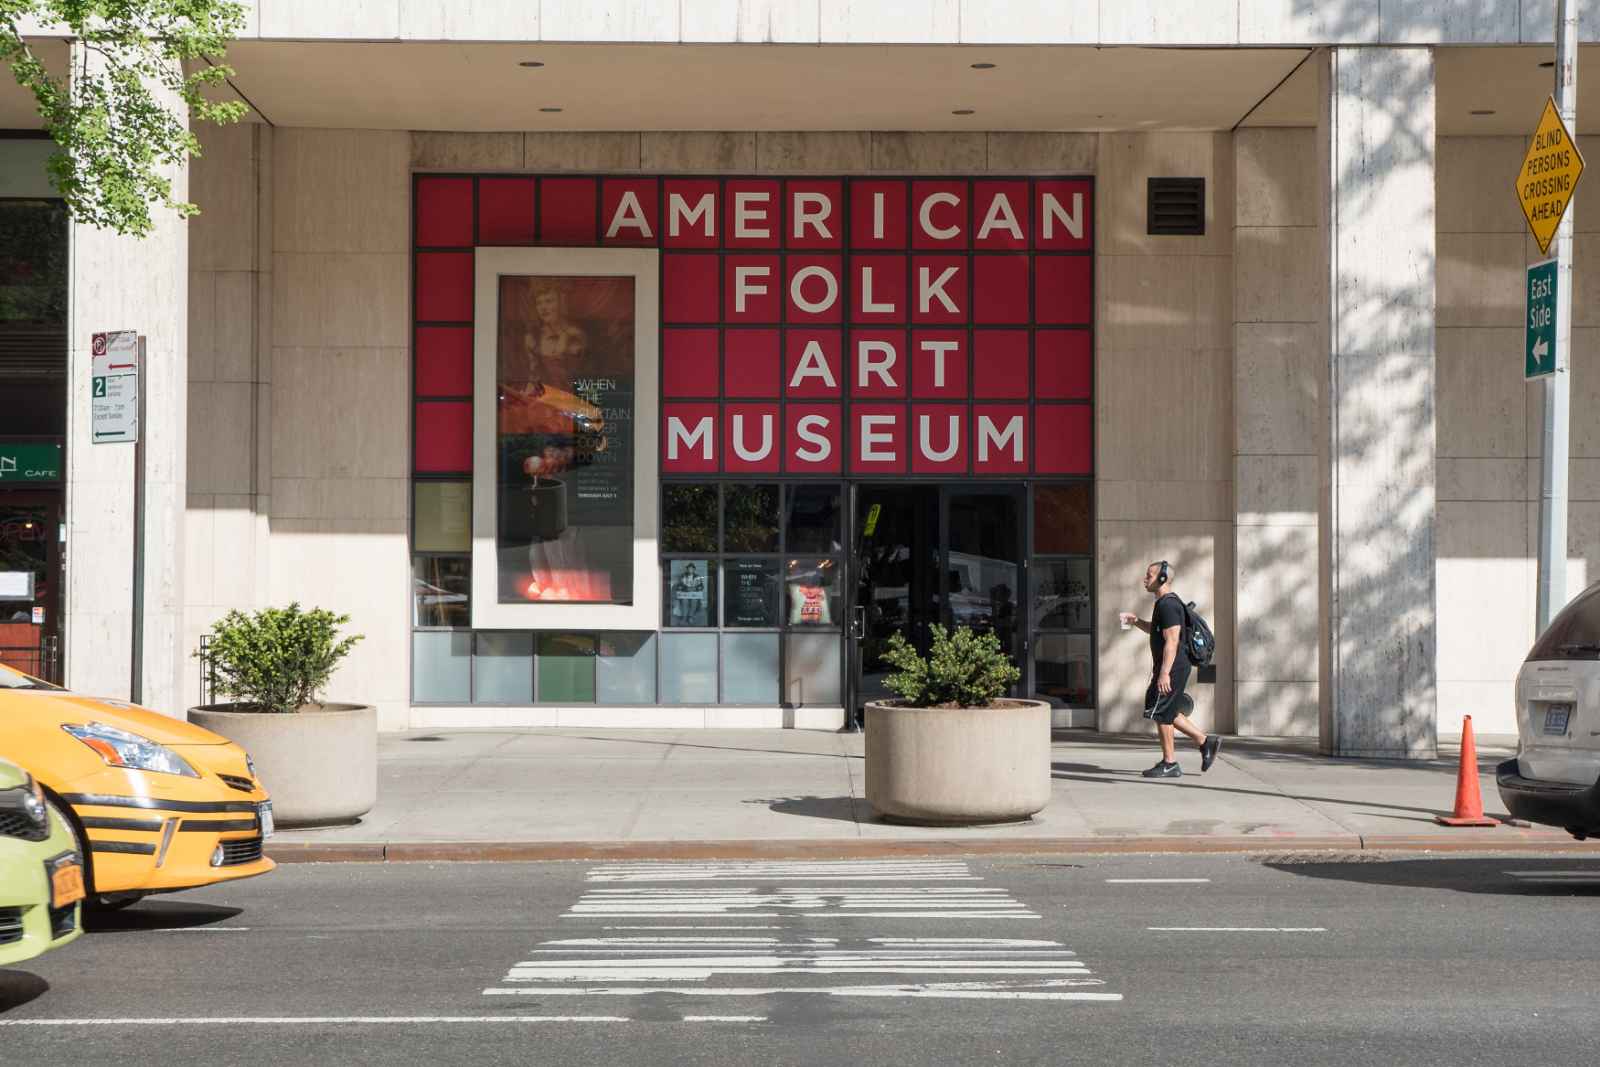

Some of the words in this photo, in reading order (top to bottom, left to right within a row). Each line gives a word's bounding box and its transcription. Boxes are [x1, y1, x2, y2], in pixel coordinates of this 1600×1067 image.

[1536, 128, 1561, 151] BLIND
[1527, 150, 1570, 176] PERSONS
[1524, 174, 1570, 200] CROSSING
[605, 190, 1085, 240] AMERICAN
[1531, 200, 1562, 221] AHEAD
[735, 266, 960, 314] FOLK
[1531, 273, 1552, 299] East
[1530, 304, 1551, 328] Side
[789, 340, 960, 389] ART
[95, 378, 103, 396] 2
[578, 379, 616, 391] WHEN
[578, 393, 602, 405] THE
[578, 422, 617, 433] NEER
[667, 414, 1024, 463] MUSEUM
[24, 470, 57, 478] CAFE
